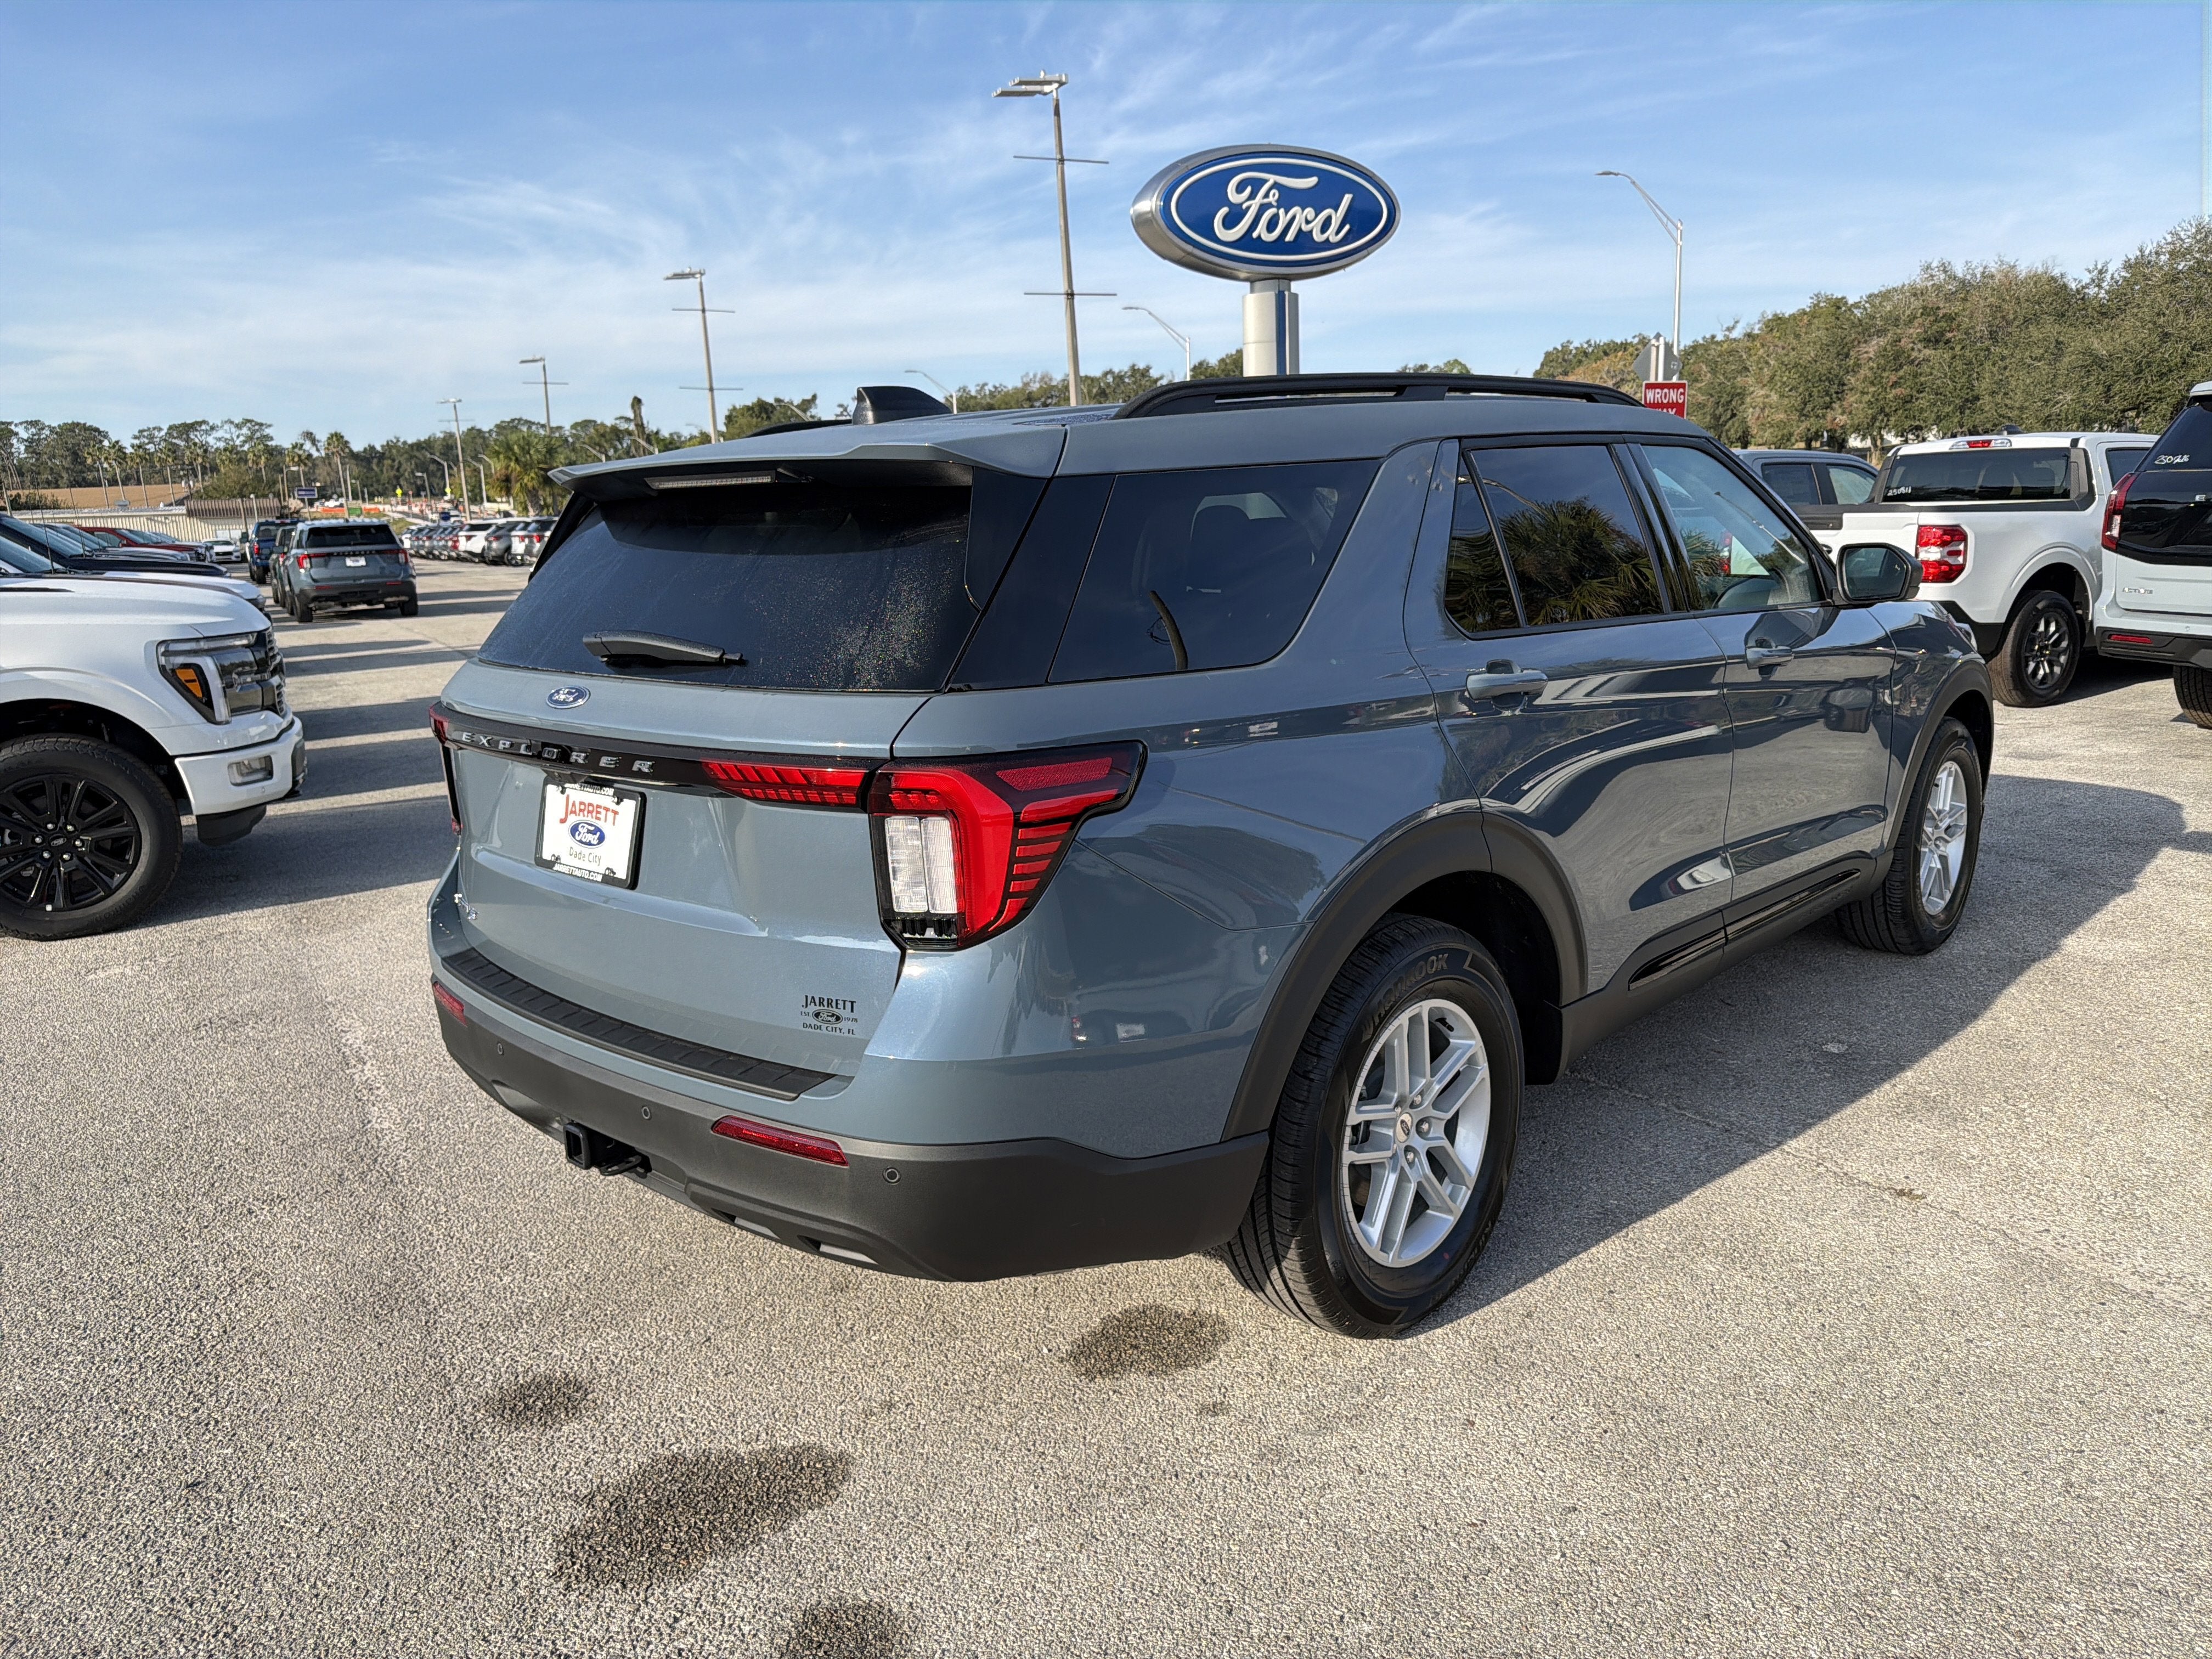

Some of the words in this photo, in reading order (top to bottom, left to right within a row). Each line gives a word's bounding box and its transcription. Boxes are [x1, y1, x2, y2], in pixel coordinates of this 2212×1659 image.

[1214, 172, 1353, 243] Ford
[1646, 388, 1684, 404] WRONG
[462, 732, 655, 775] EXPLORER
[559, 794, 619, 826] JARRETT
[574, 823, 600, 844] Ford
[569, 847, 586, 861] Dade
[588, 853, 602, 866] City
[552, 863, 603, 882] JARRETTAUTO.COM
[802, 995, 856, 1013] JARRETT
[817, 1012, 837, 1022] Ford
[803, 1022, 823, 1031] DADE
[826, 1025, 845, 1035] CITY,
